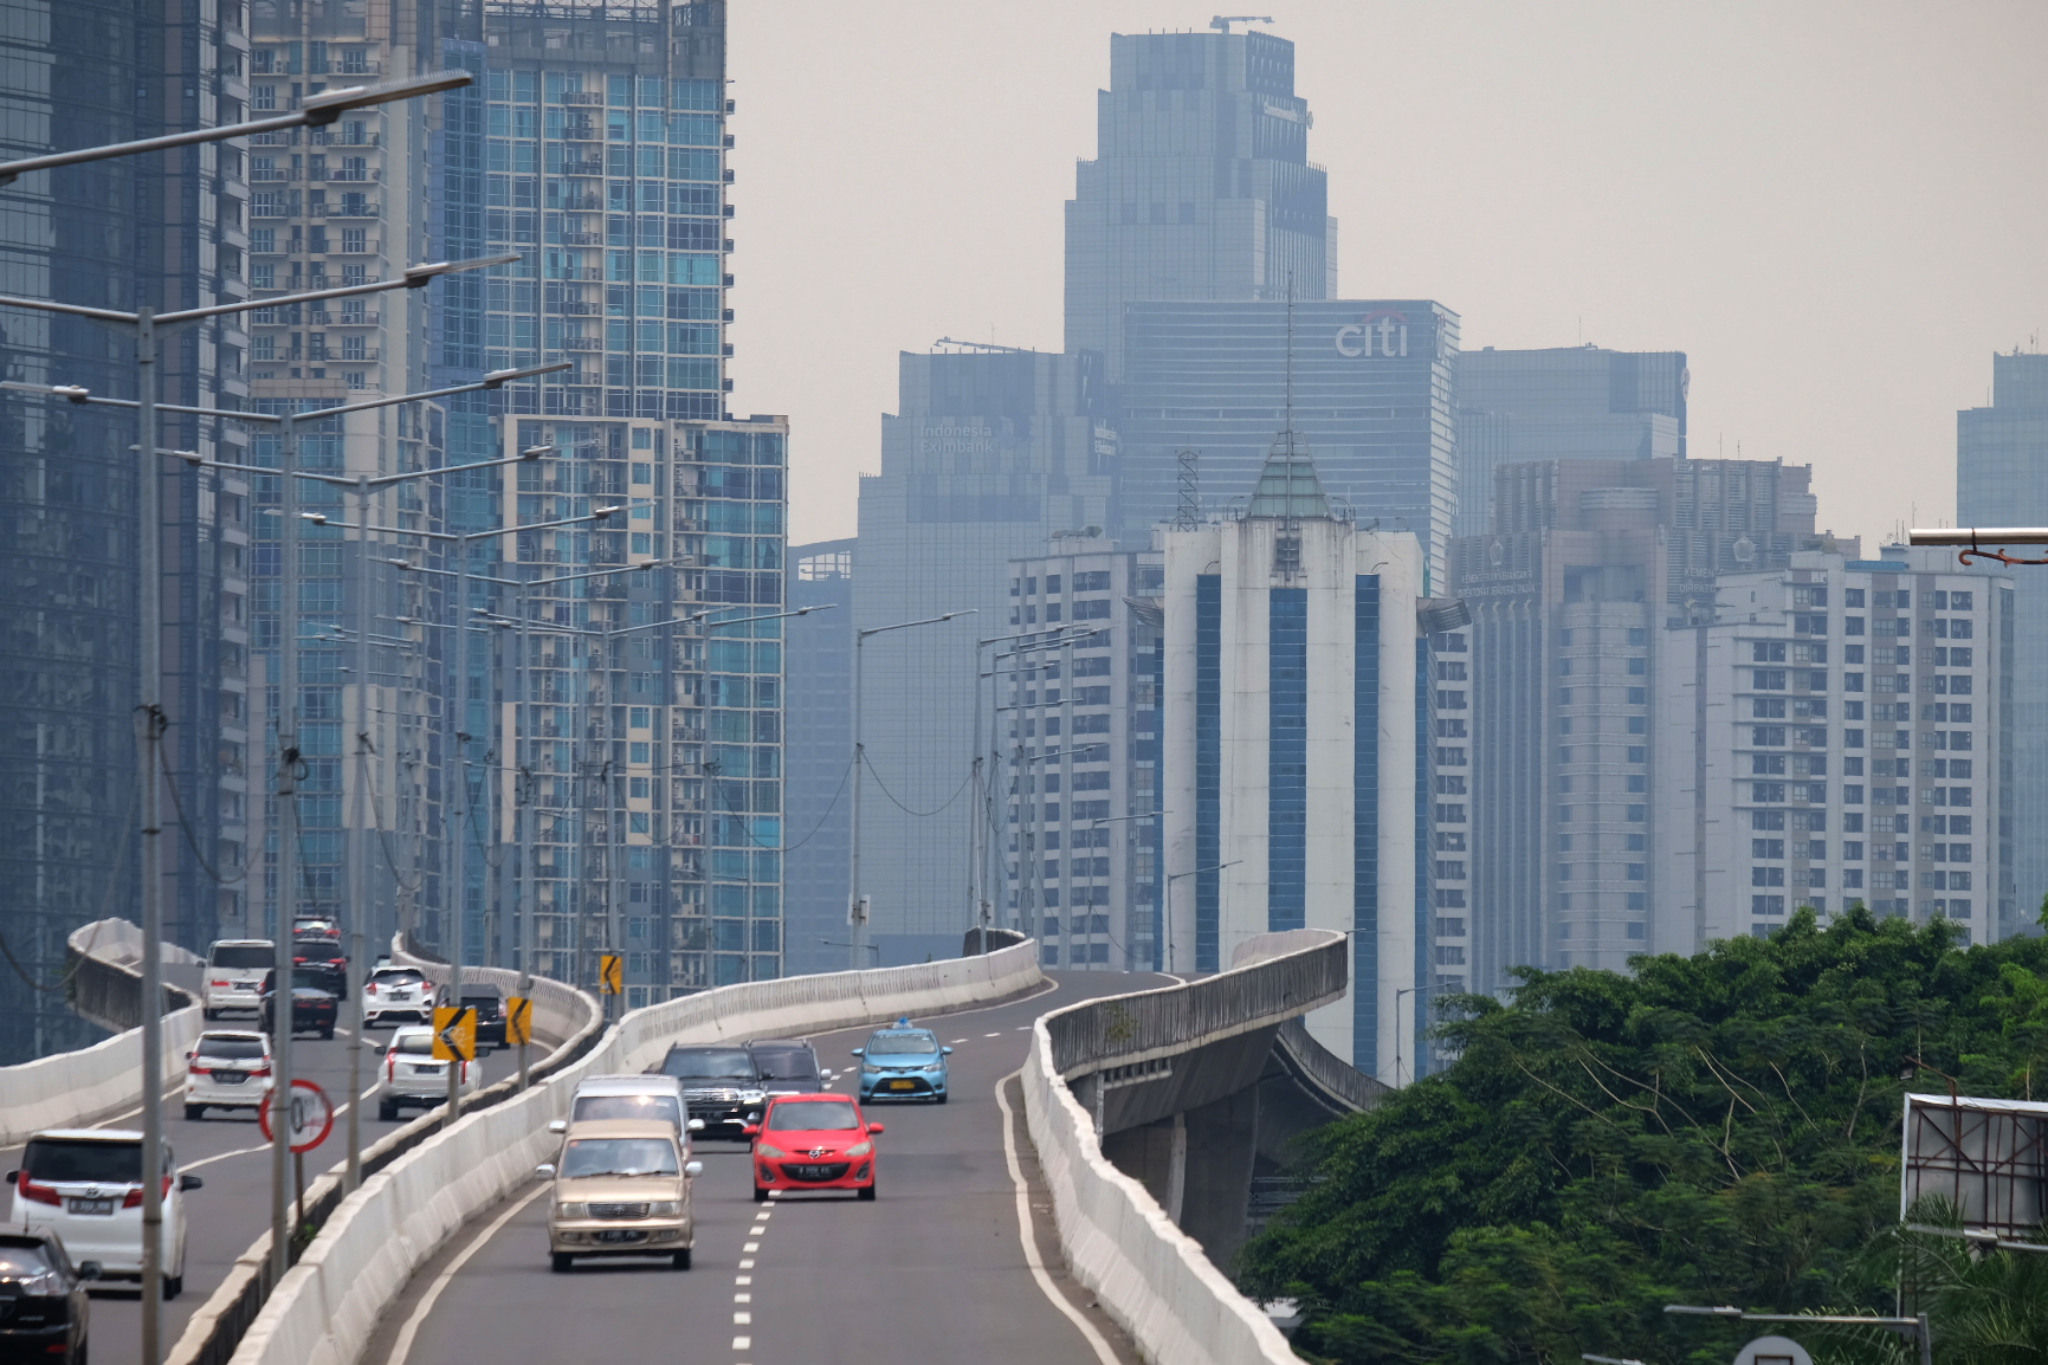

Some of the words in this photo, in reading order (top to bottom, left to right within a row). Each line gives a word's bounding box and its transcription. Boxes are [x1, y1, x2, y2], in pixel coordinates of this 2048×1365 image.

[1335, 316, 1408, 357] citi
[919, 423, 992, 437] Indonesia
[919, 439, 993, 454] Eximbank
